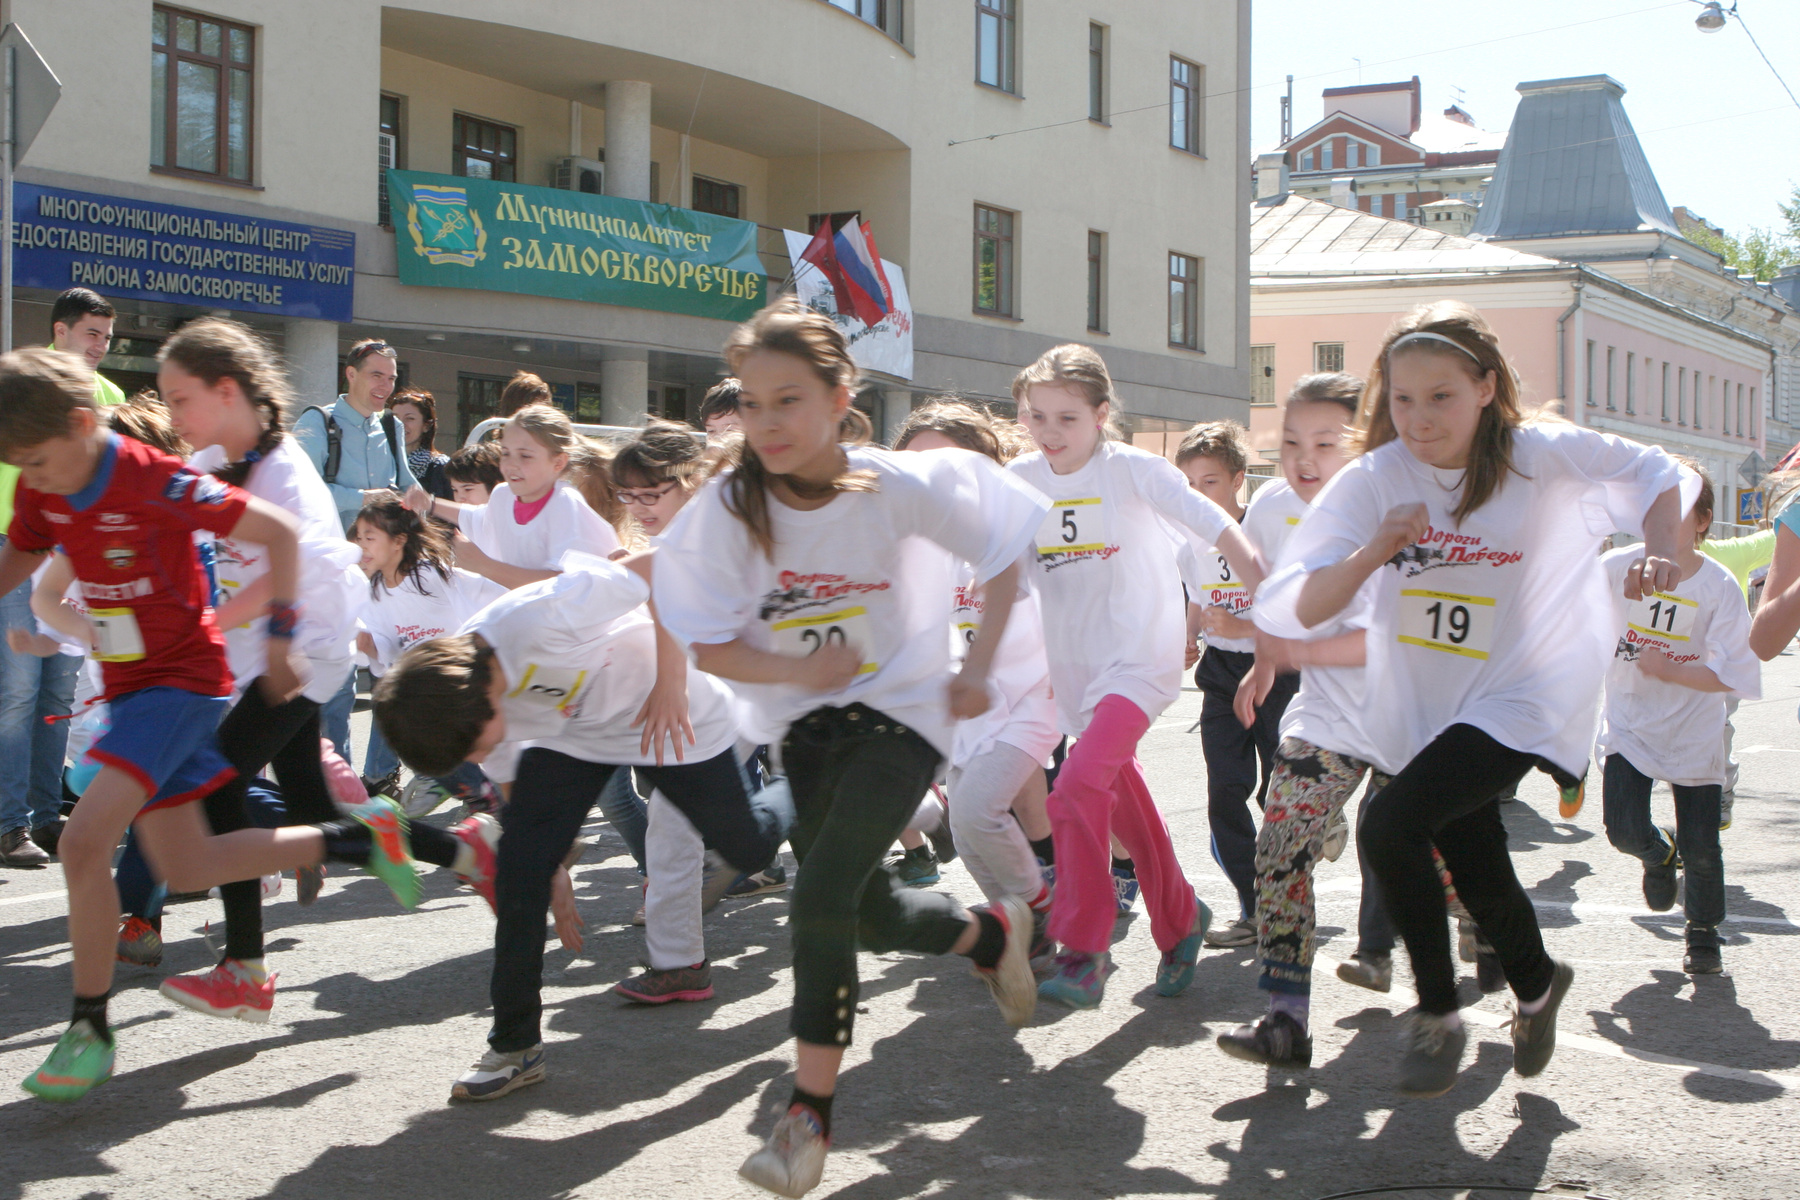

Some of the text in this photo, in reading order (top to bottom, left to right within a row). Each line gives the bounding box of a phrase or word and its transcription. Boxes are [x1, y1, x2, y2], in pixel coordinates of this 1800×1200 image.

[39, 194, 259, 246] МНОГОФУНКЦИОНАЛЬНЫЙ
[262, 227, 311, 252] ЦЕНТР
[495, 192, 712, 253] Муниципалитет
[0, 220, 353, 286] ЕДОСТАВЛЕНИЯ ГОСУДАРСТВЕННЫХ УСЛУГ
[501, 236, 760, 300] ЗАМОСКВОРЕЧЬЕ
[72, 259, 283, 306] РАЙОНА ЗАМОСКВОРЕЧЬЕ
[1062, 509, 1078, 543] 5
[1217, 555, 1231, 582] 3
[1446, 546, 1523, 568] Победы
[1426, 601, 1471, 644] 19
[1649, 600, 1677, 633] 11
